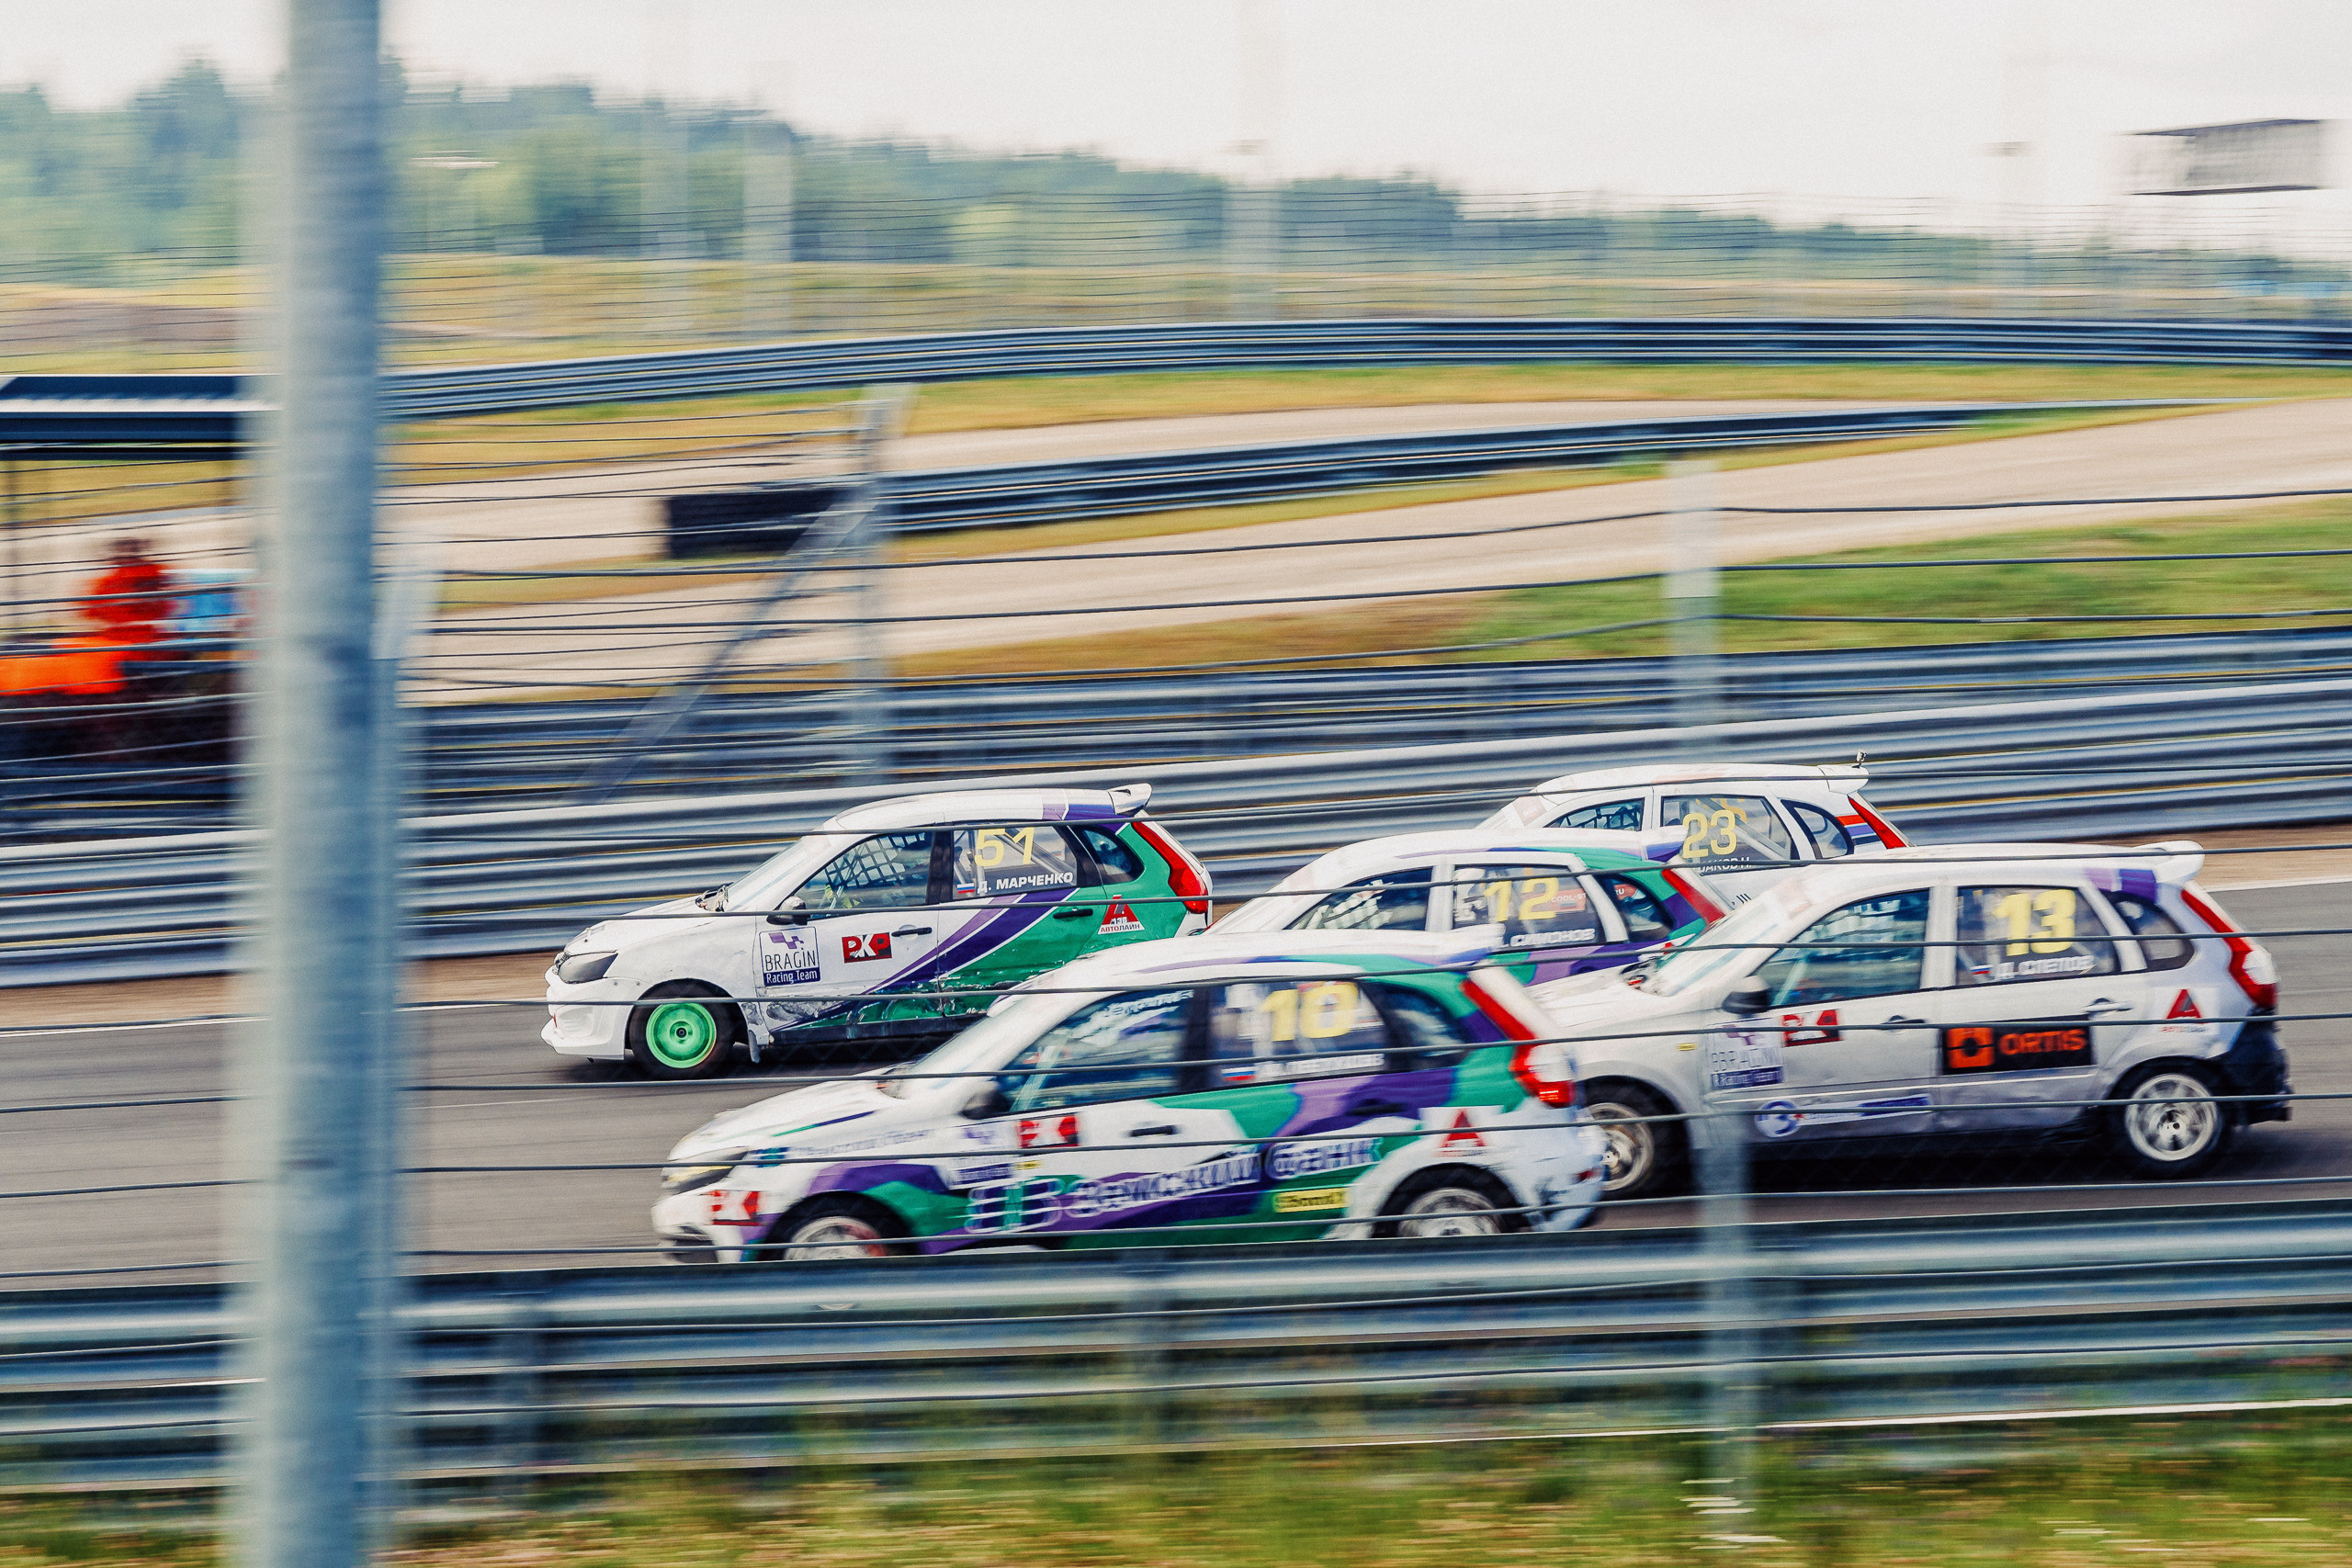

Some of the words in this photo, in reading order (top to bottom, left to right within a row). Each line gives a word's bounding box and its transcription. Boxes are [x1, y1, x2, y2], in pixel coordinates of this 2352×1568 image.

[975, 826, 1035, 866] 51
[1682, 810, 1736, 859] 23
[996, 872, 1074, 891] МАРЧЕНКО
[1483, 876, 1559, 922] 12
[1992, 889, 2076, 956] 13
[764, 947, 816, 972] BRAGIN
[766, 971, 794, 985] Racing
[797, 970, 818, 981] Team
